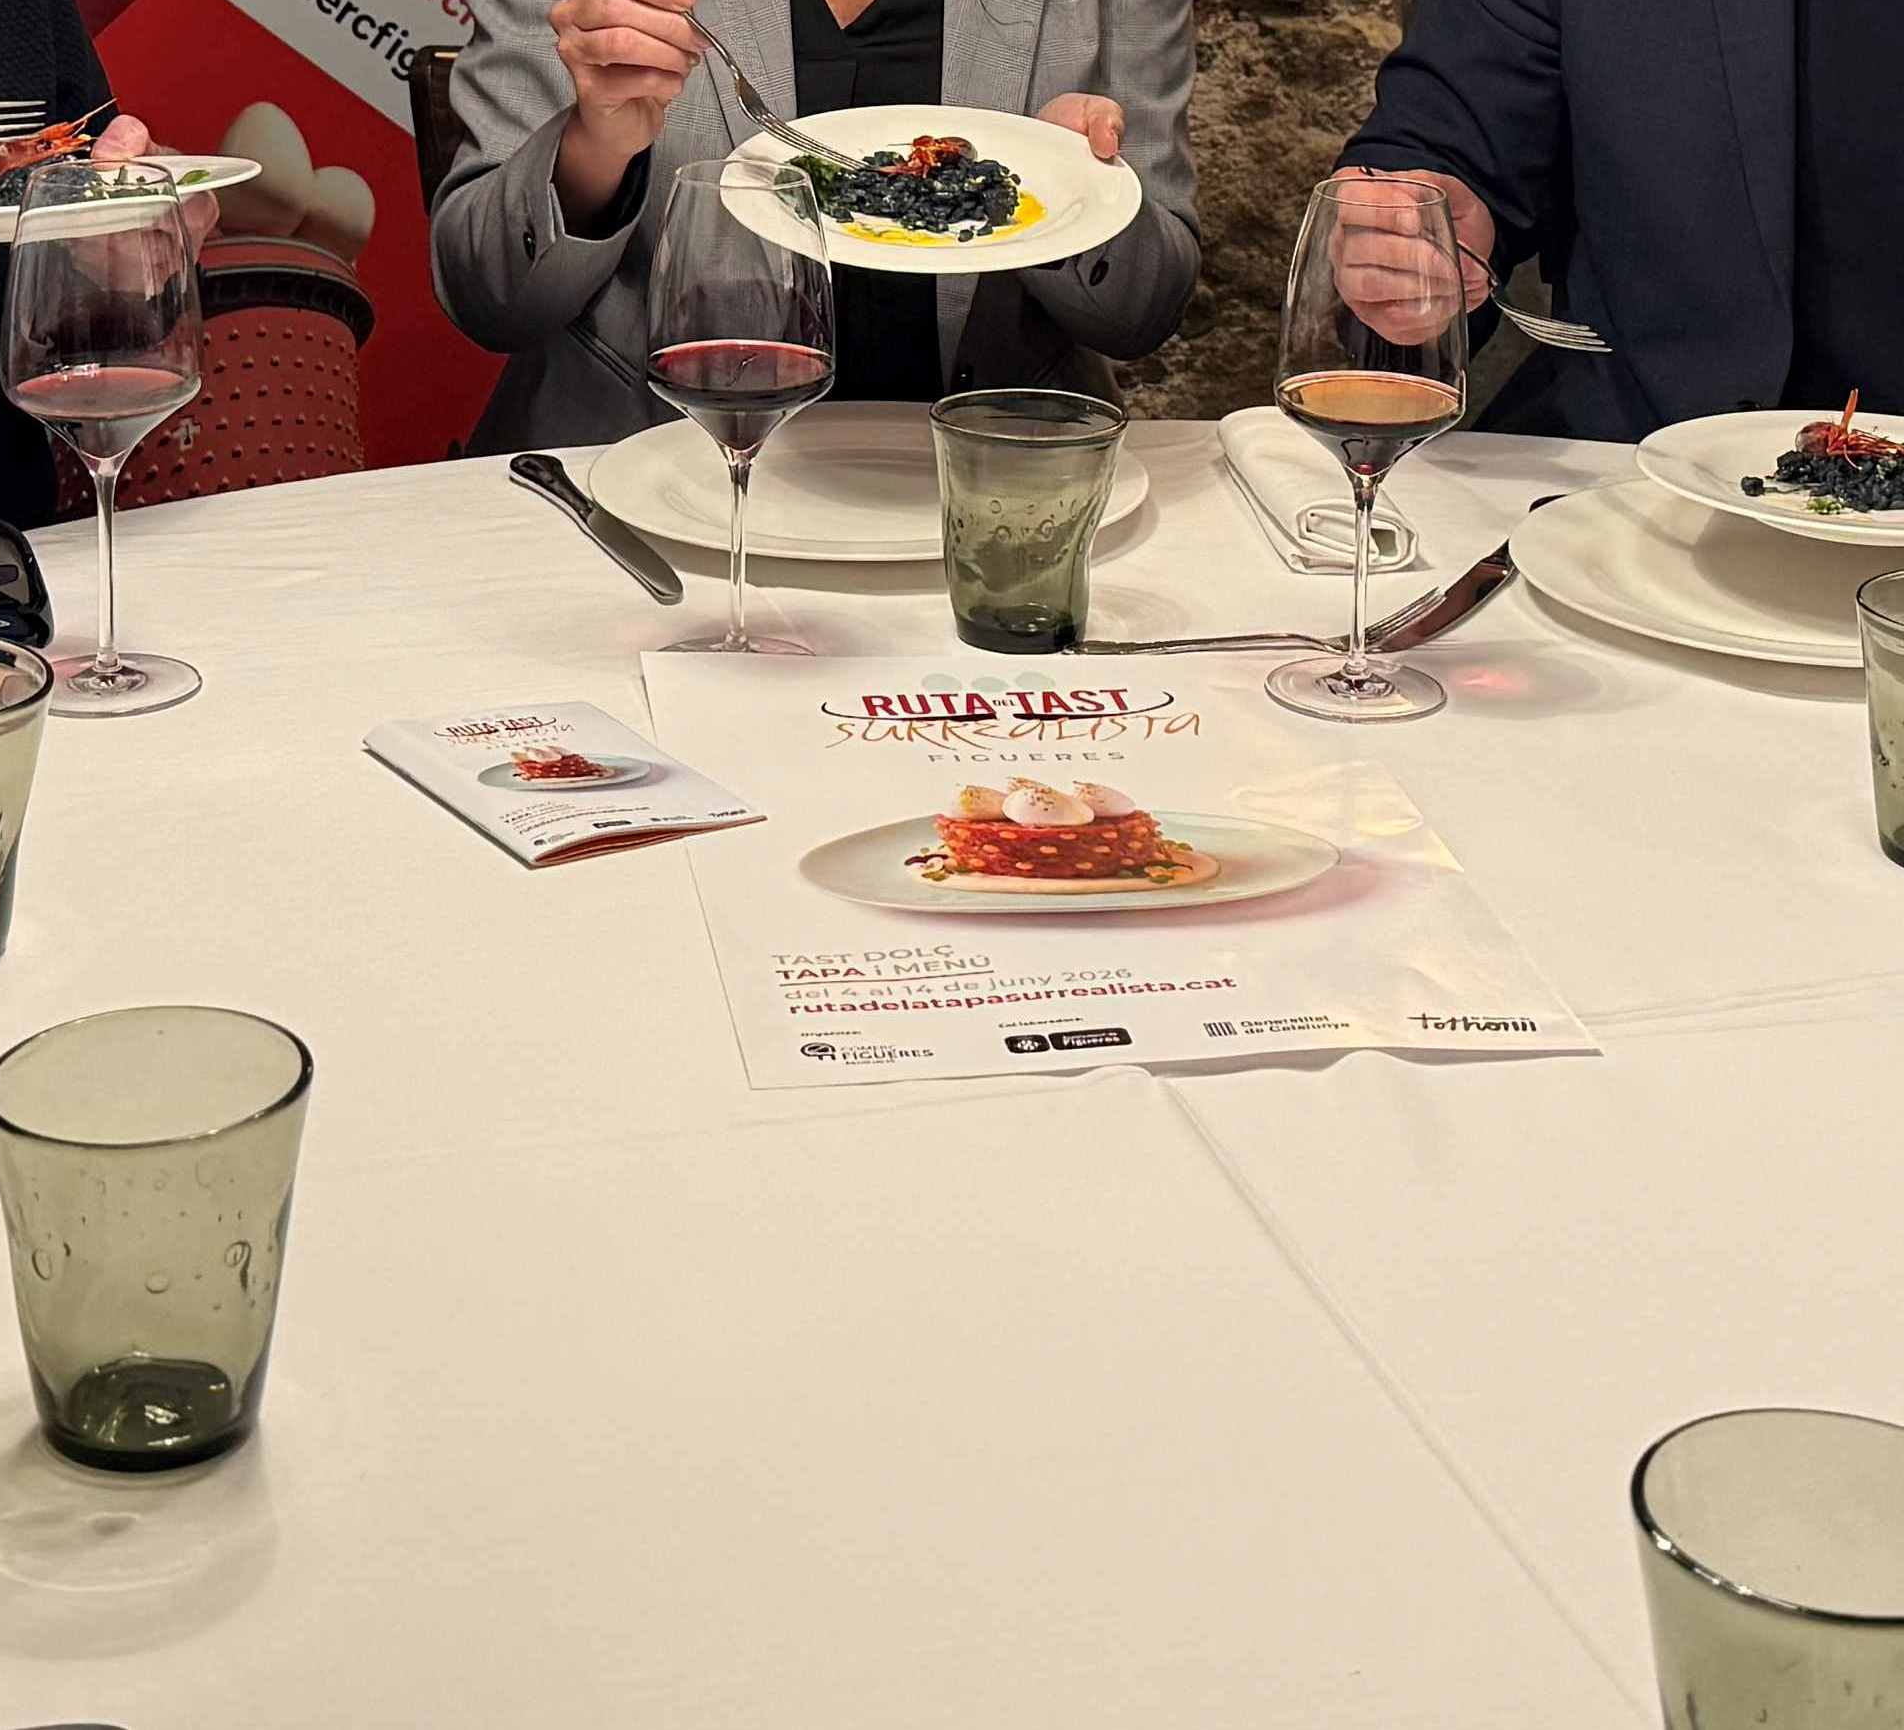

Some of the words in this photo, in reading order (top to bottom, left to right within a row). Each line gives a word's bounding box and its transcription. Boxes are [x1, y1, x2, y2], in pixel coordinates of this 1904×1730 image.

[862, 693, 999, 719] RUTA
[1006, 688, 1129, 716] TAST
[928, 751, 1125, 763] FIGUERES
[771, 953, 852, 966] TAST
[863, 944, 956, 963] DOLÇ
[775, 967, 866, 980] TAPA
[893, 954, 992, 976] MENÚ
[784, 987, 830, 1000] del
[943, 981, 979, 993] de
[988, 974, 1052, 992] juny
[789, 977, 1238, 1014] rutadelatapasurrealista.cat
